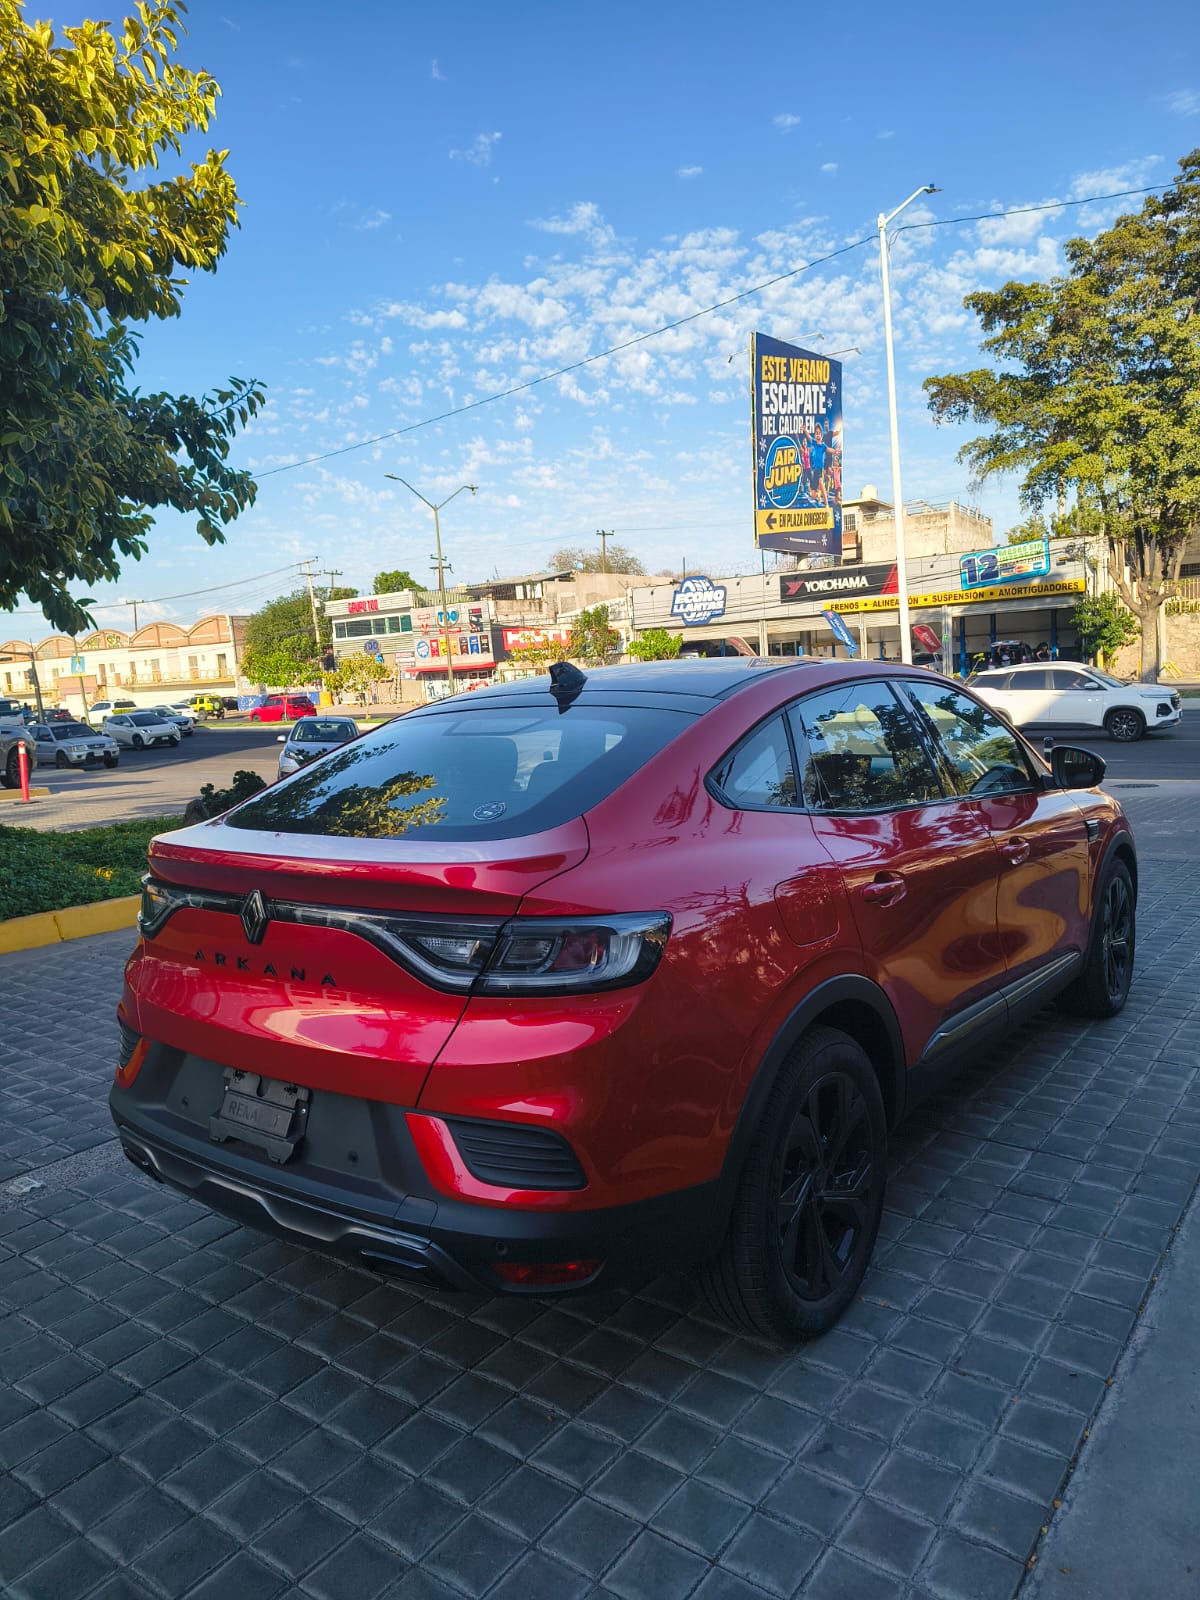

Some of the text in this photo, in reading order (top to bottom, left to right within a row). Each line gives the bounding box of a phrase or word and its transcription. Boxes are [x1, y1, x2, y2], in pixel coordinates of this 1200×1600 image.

[761, 355, 831, 384] ESTE VERANO
[761, 378, 827, 415] ESCÁPATE
[762, 416, 778, 435] DEL
[805, 418, 815, 434] EN
[775, 448, 797, 466] AIR
[765, 464, 803, 489] JUMP
[779, 513, 787, 528] EN
[787, 512, 803, 528] PLAZA
[962, 554, 1000, 584] 12
[675, 590, 726, 605] ECONO
[806, 577, 869, 593] YOKOHAMA
[830, 581, 1080, 612] FRENOS ALINEAÓN SUSPENSIÓN AMORTIGUADORES
[673, 600, 725, 613] LLANTAS
[194, 949, 338, 987] ARKANA
[228, 1099, 281, 1129] RENAT
